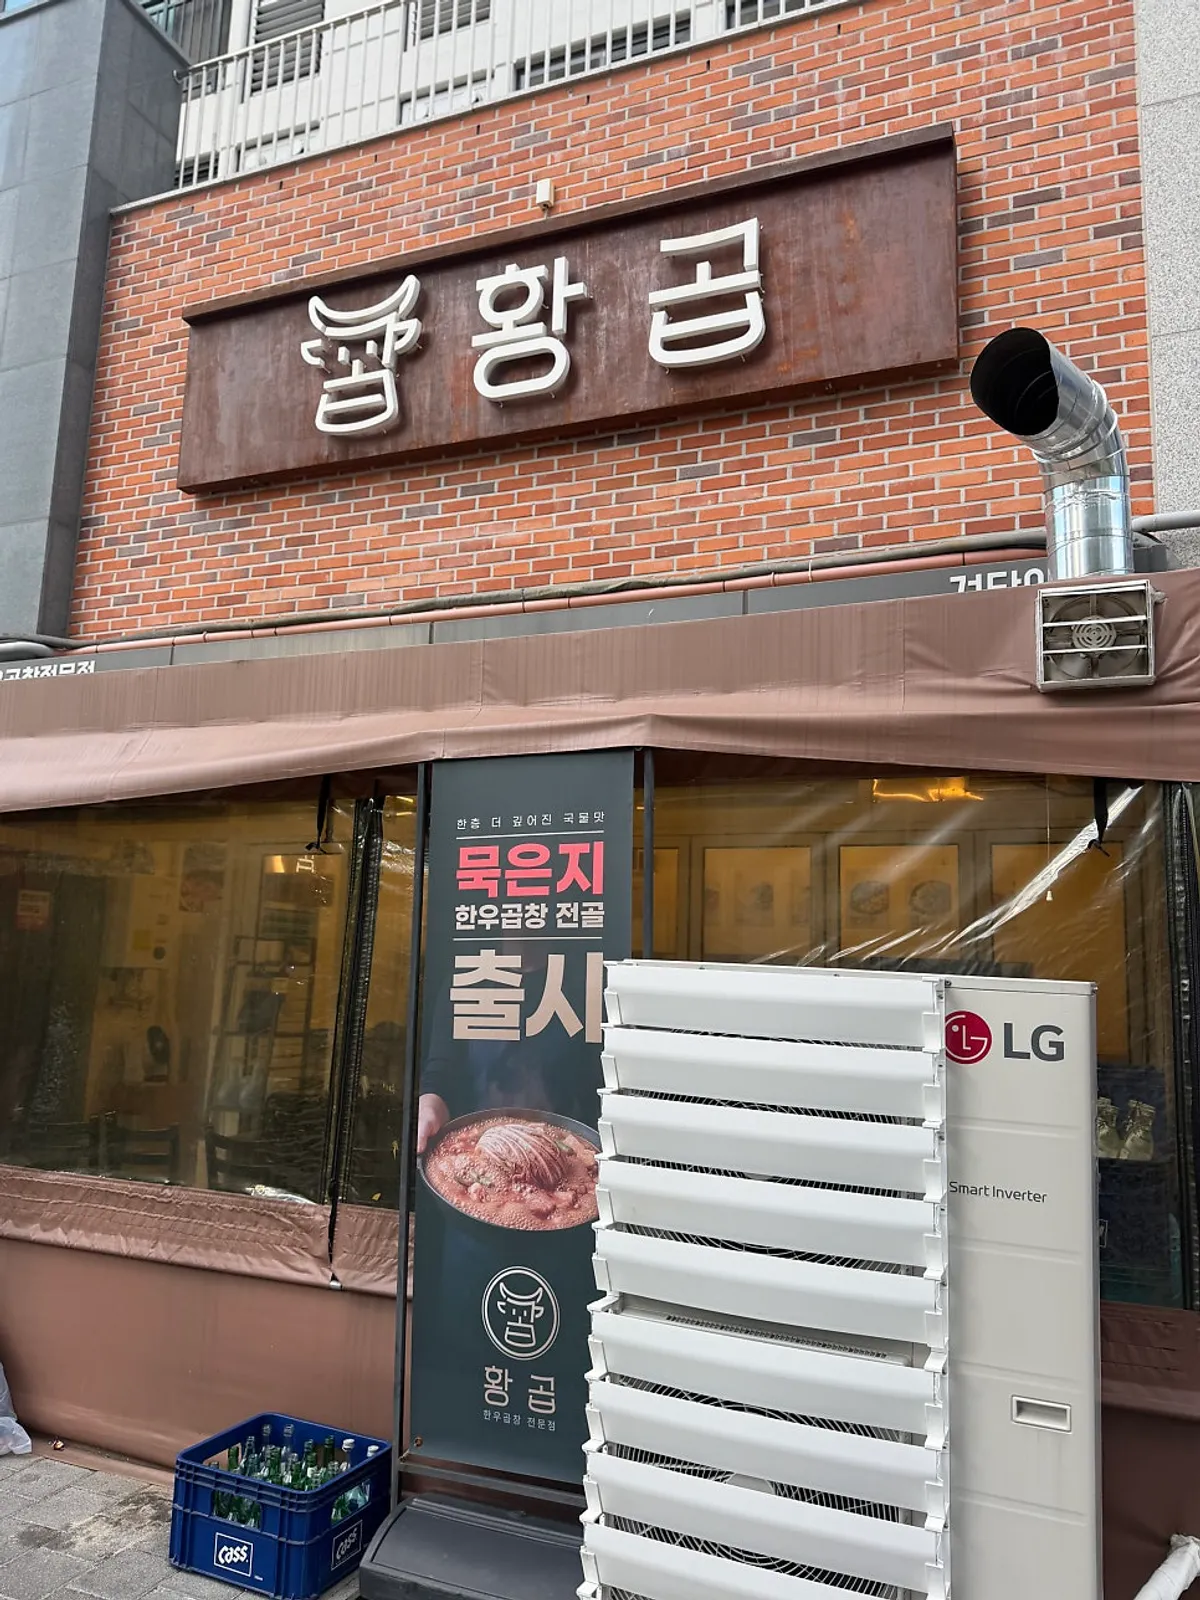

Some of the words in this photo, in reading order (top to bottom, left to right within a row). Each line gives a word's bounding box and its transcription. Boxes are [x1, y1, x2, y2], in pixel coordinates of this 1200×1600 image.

[456, 818, 481, 830] 한층
[491, 816, 501, 828] 더
[512, 813, 553, 828] 깊어진
[563, 811, 605, 825] 국물맛
[456, 841, 605, 898] 묵은지
[455, 903, 549, 931] 한우곱창
[555, 902, 605, 929] 전골
[450, 949, 604, 1043] 출시
[1003, 1022, 1065, 1062] LG
[949, 1181, 990, 1197] Smart
[992, 1185, 1047, 1203] Inverter
[483, 1409, 521, 1426] 한우곱창
[527, 1417, 556, 1432] 전문점
